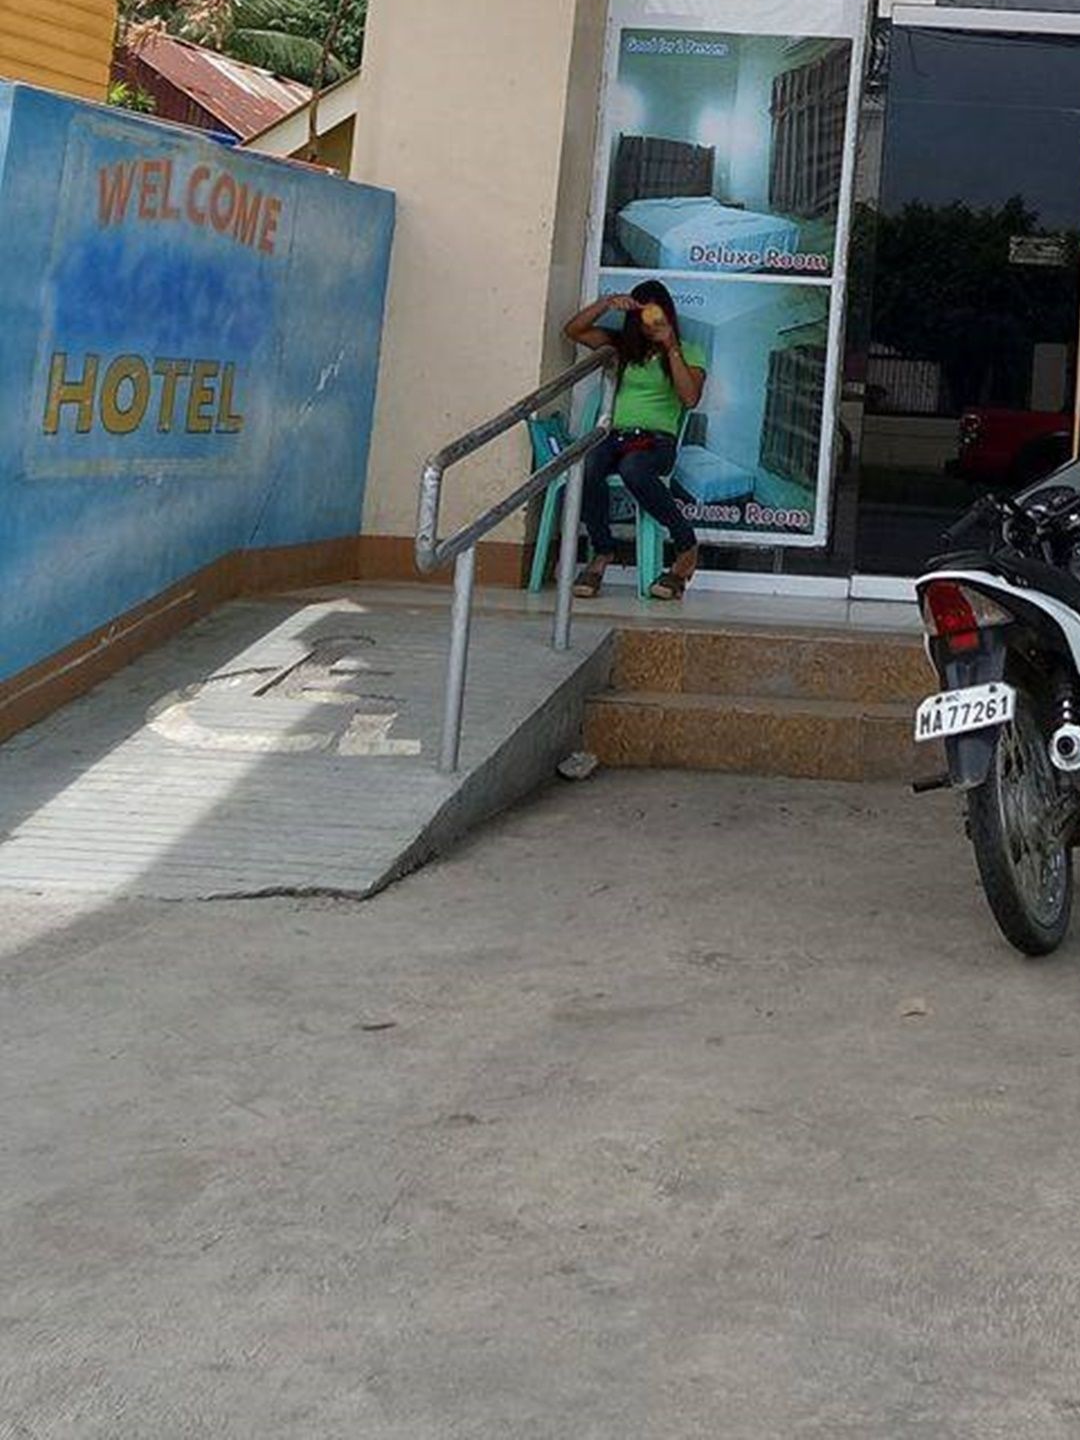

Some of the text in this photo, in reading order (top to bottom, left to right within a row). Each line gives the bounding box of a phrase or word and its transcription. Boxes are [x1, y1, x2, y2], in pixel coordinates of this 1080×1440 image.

[97, 157, 283, 256] WELCOME
[689, 245, 828, 271] Deluxe Room
[43, 351, 245, 436] HOTEL
[745, 502, 811, 527] Room
[948, 694, 1009, 729] 77261
